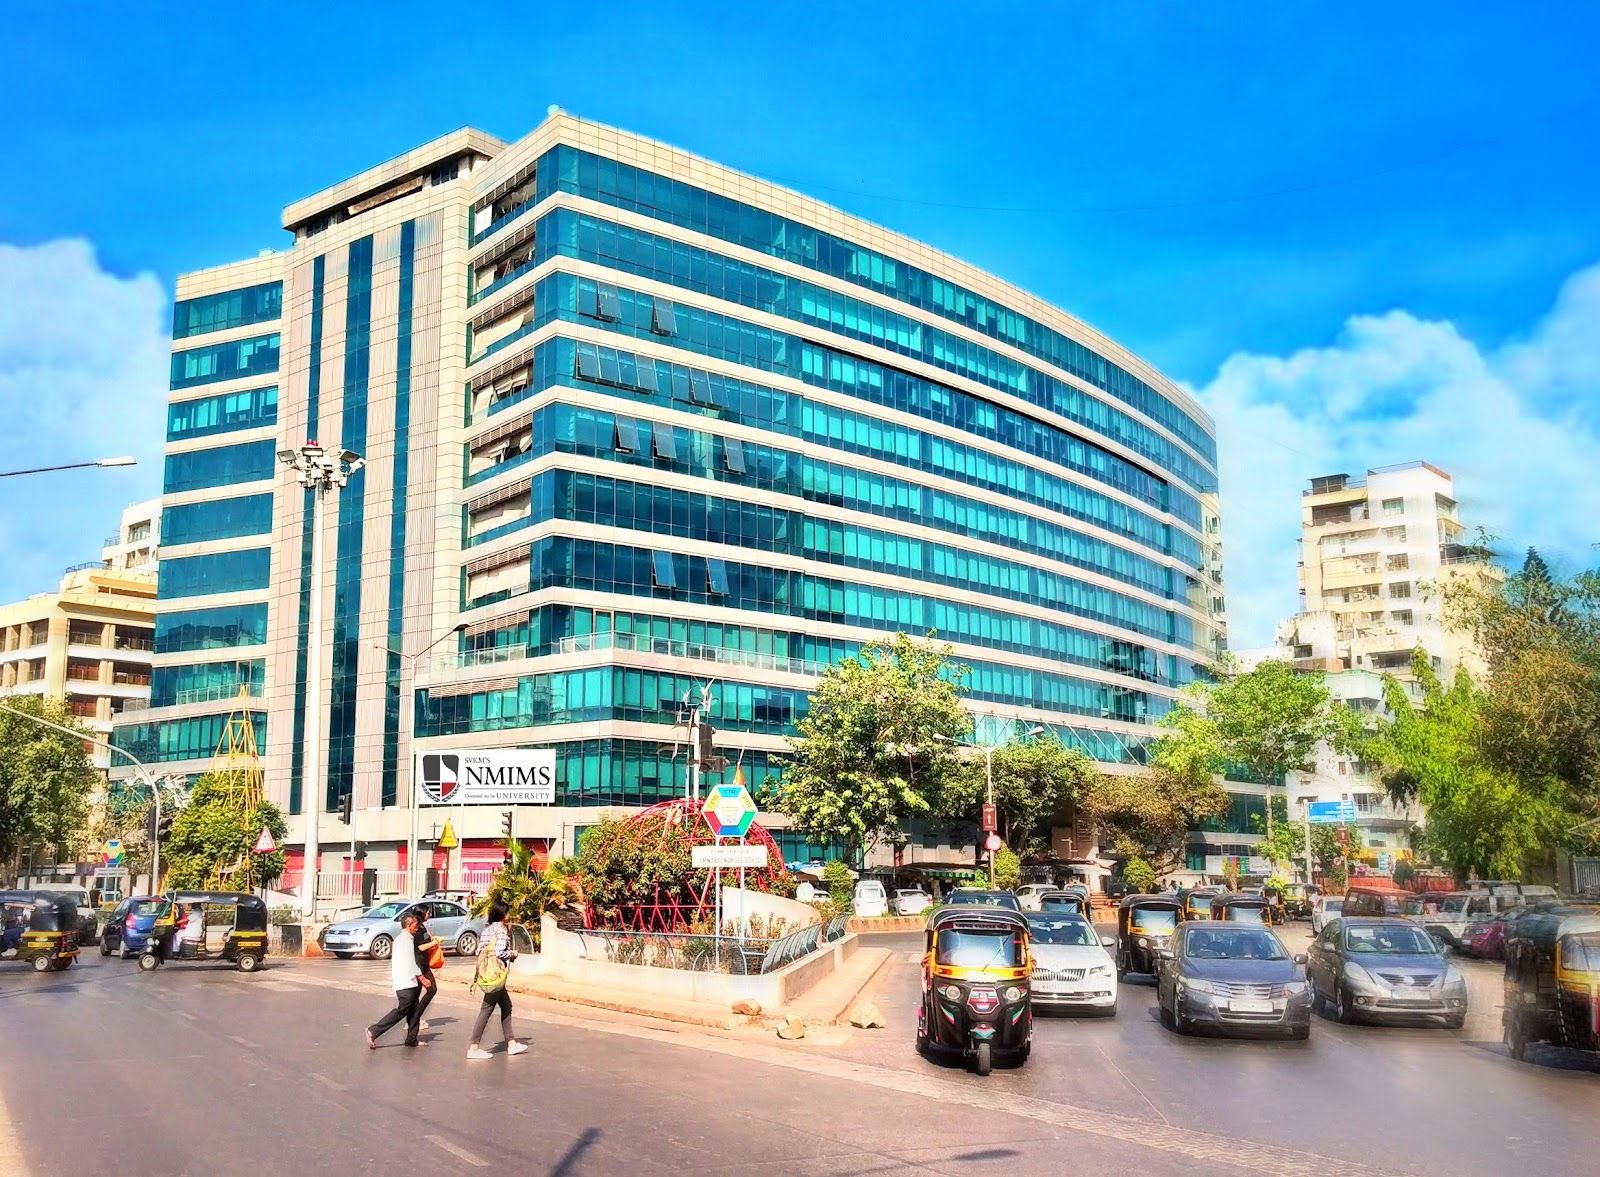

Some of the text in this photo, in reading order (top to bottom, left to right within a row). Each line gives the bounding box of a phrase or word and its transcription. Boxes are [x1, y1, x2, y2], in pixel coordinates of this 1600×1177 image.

[465, 766, 550, 786] NMIMS
[496, 792, 550, 800] UNIVERSITY
[745, 856, 764, 864] SCHOOL
